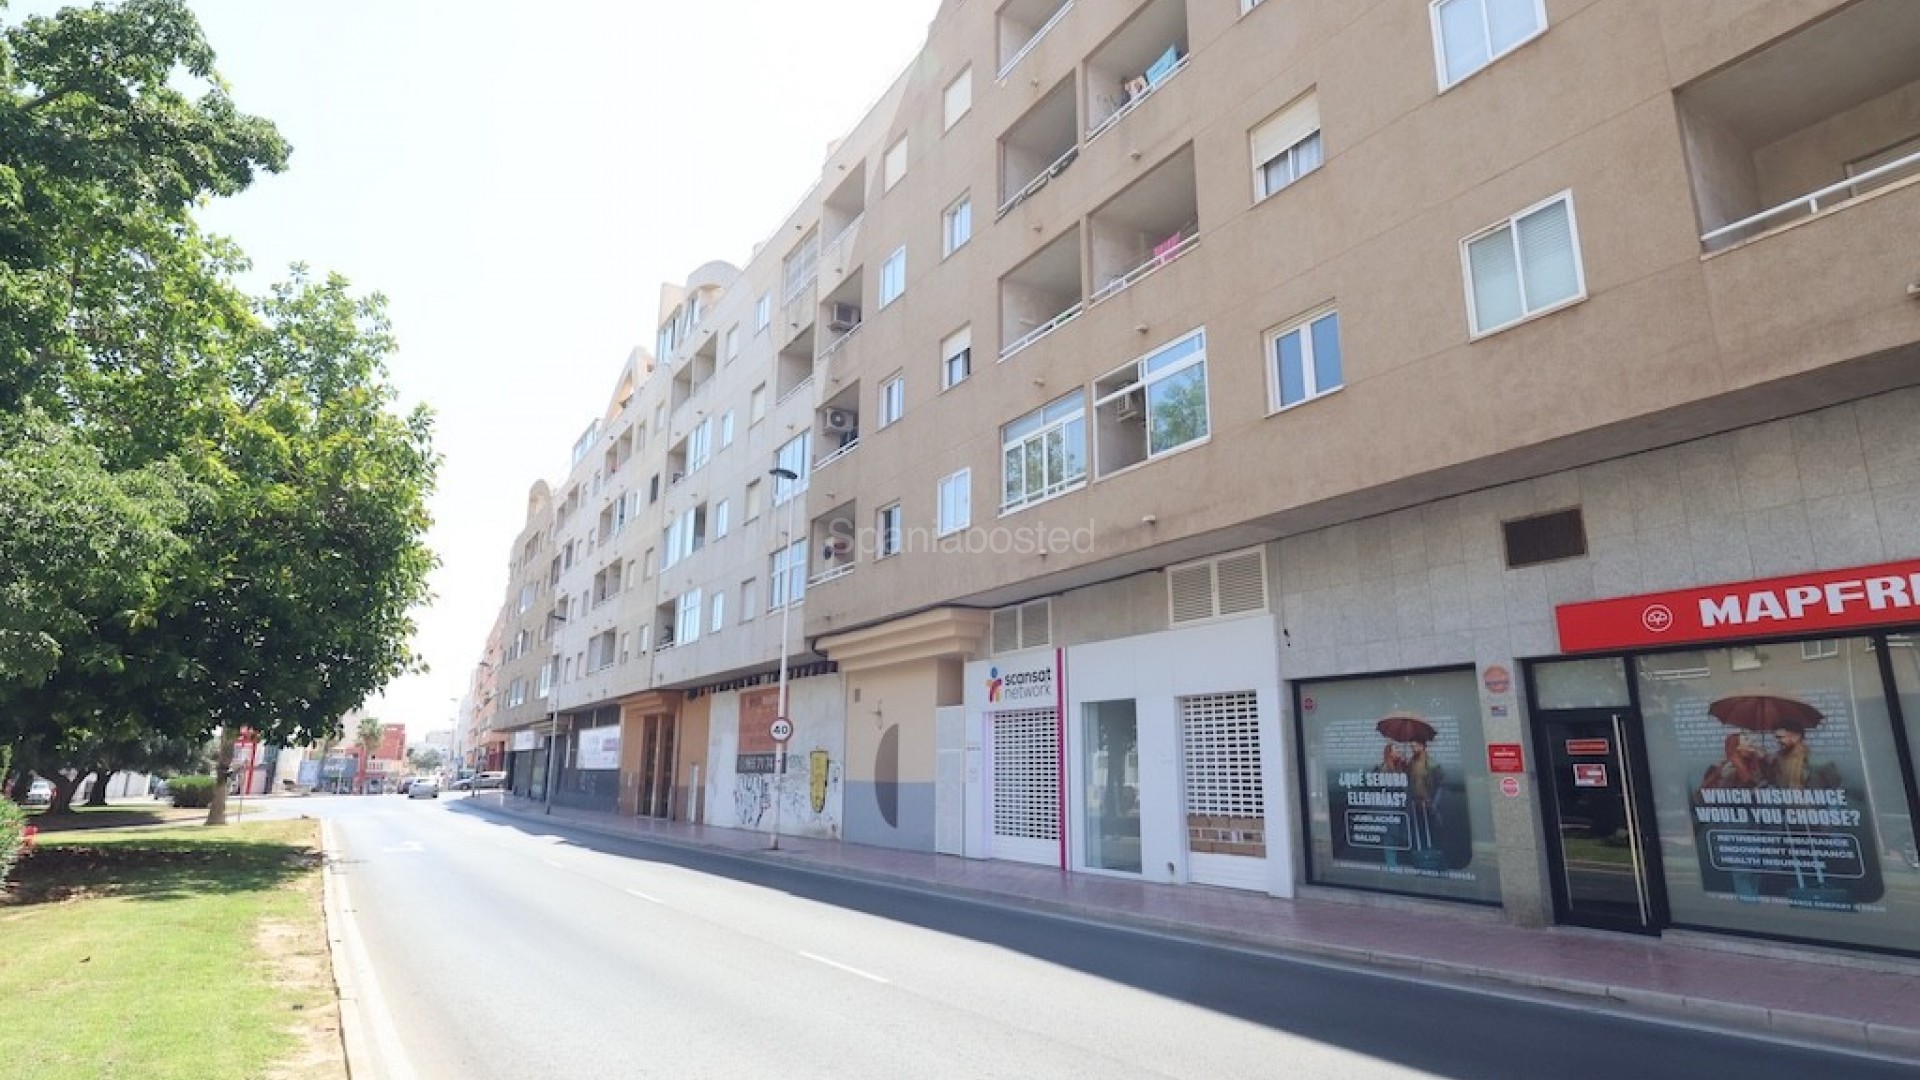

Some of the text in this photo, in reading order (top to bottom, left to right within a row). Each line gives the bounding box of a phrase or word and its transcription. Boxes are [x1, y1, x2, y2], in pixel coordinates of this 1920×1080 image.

[1699, 573, 1920, 628] MAPFR
[1005, 667, 1051, 686] scansat
[1005, 684, 1051, 699] network
[773, 725, 789, 735] 40
[1700, 787, 1847, 806] WHICH INSURANCE
[1695, 806, 1861, 827] WOULD YOU CHOOSE?
